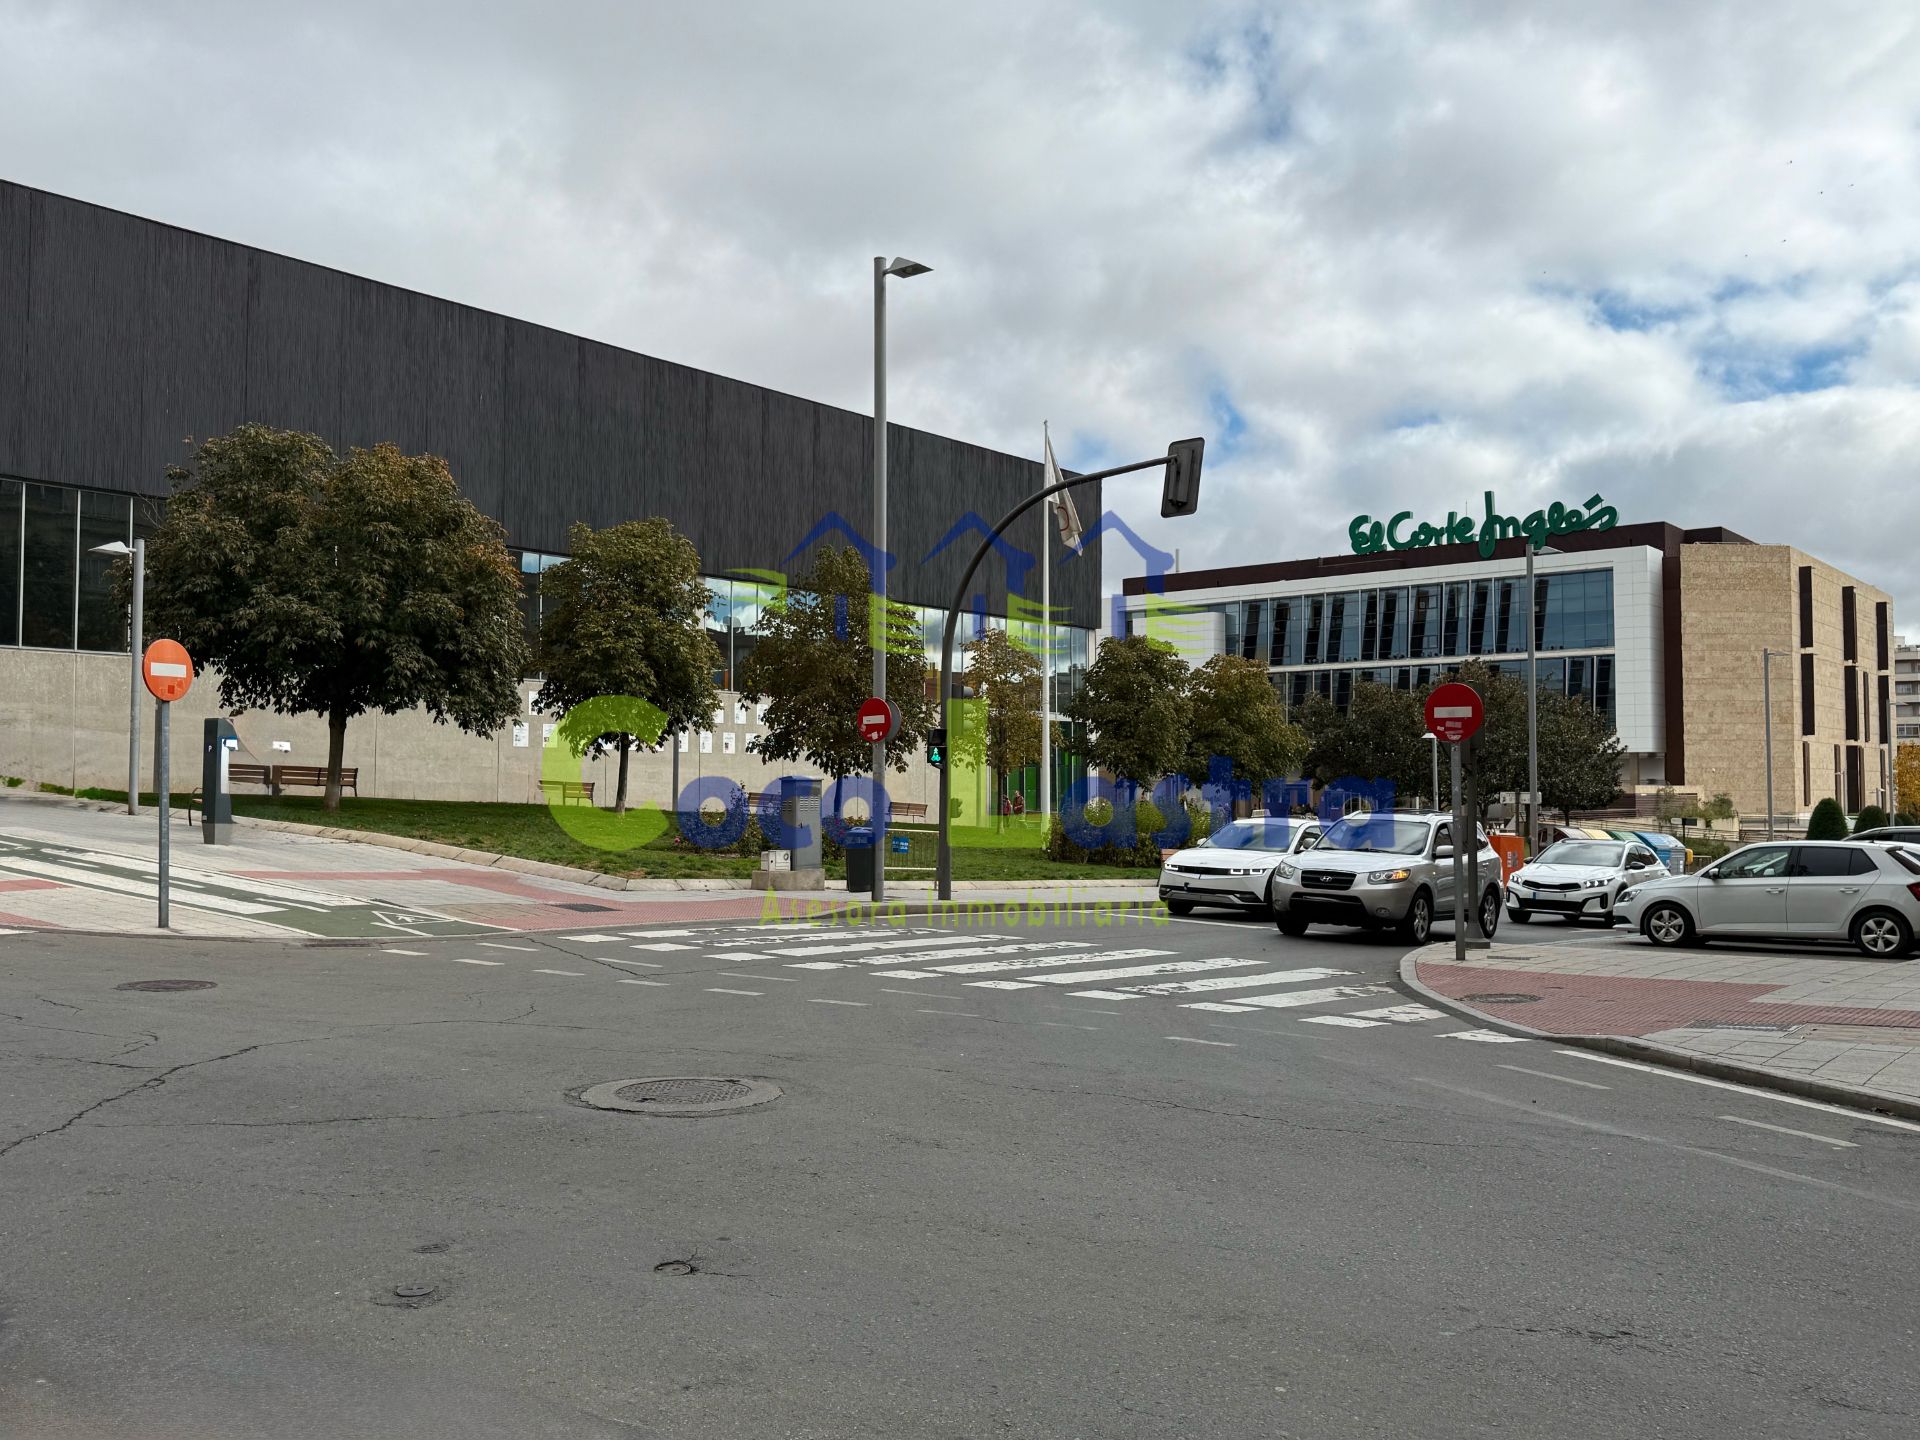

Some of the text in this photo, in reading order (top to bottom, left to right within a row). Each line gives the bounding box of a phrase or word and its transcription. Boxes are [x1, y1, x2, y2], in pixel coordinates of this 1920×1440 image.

[1349, 490, 1619, 559] El Corte Inglés
